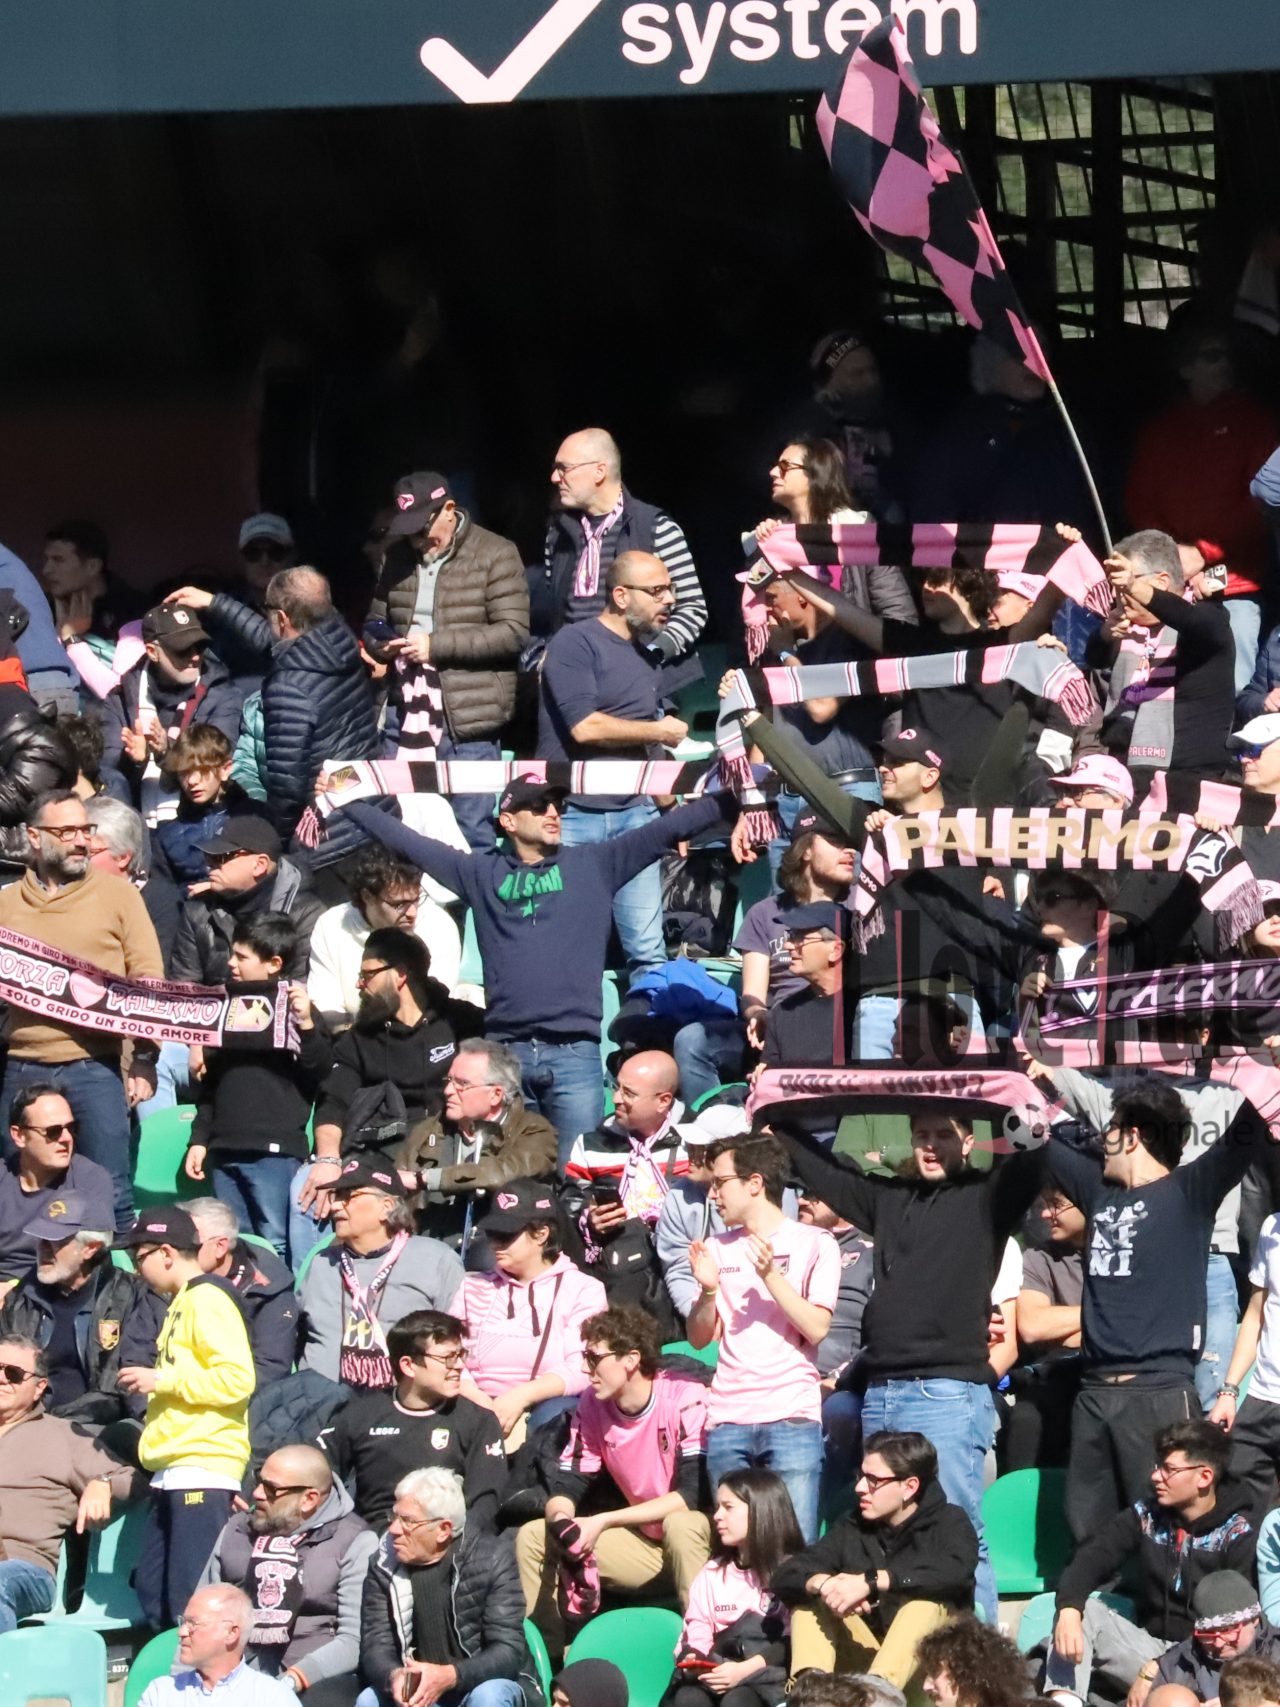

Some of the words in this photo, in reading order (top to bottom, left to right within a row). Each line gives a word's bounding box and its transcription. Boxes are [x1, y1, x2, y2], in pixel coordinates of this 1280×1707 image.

[621, 0, 977, 84] system
[892, 816, 1182, 861] PALERMO
[0, 929, 30, 948] DREMO
[0, 949, 67, 994] ORZA
[108, 984, 221, 1024] PALERMO
[6, 989, 41, 1007] SOLO
[46, 1003, 90, 1022] GRIDO
[95, 1016, 115, 1028] UN
[120, 1021, 155, 1036] SOLO
[160, 1028, 211, 1042] AMORE
